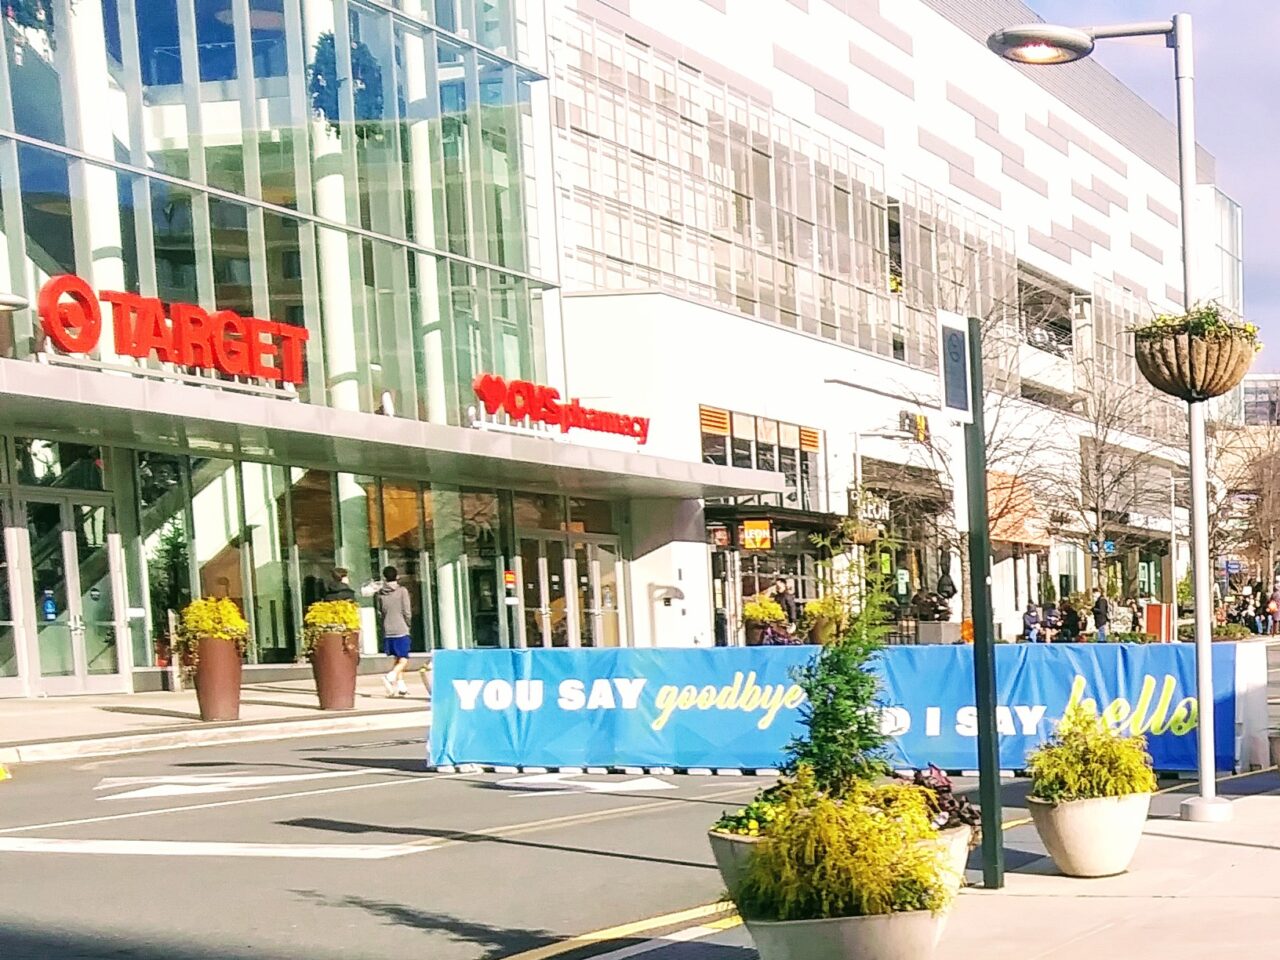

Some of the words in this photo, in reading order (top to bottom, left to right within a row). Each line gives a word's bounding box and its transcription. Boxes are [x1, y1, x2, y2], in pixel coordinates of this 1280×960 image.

[99, 290, 310, 384] TARGET
[507, 379, 561, 425] CVS
[559, 397, 650, 445] pharmacy
[744, 528, 770, 539] LEON
[452, 678, 544, 711] YOU
[557, 678, 648, 711] SAY
[651, 671, 806, 731] goodbye
[925, 706, 941, 737] I
[955, 705, 1047, 737] SAY
[1057, 674, 1198, 737] hello
